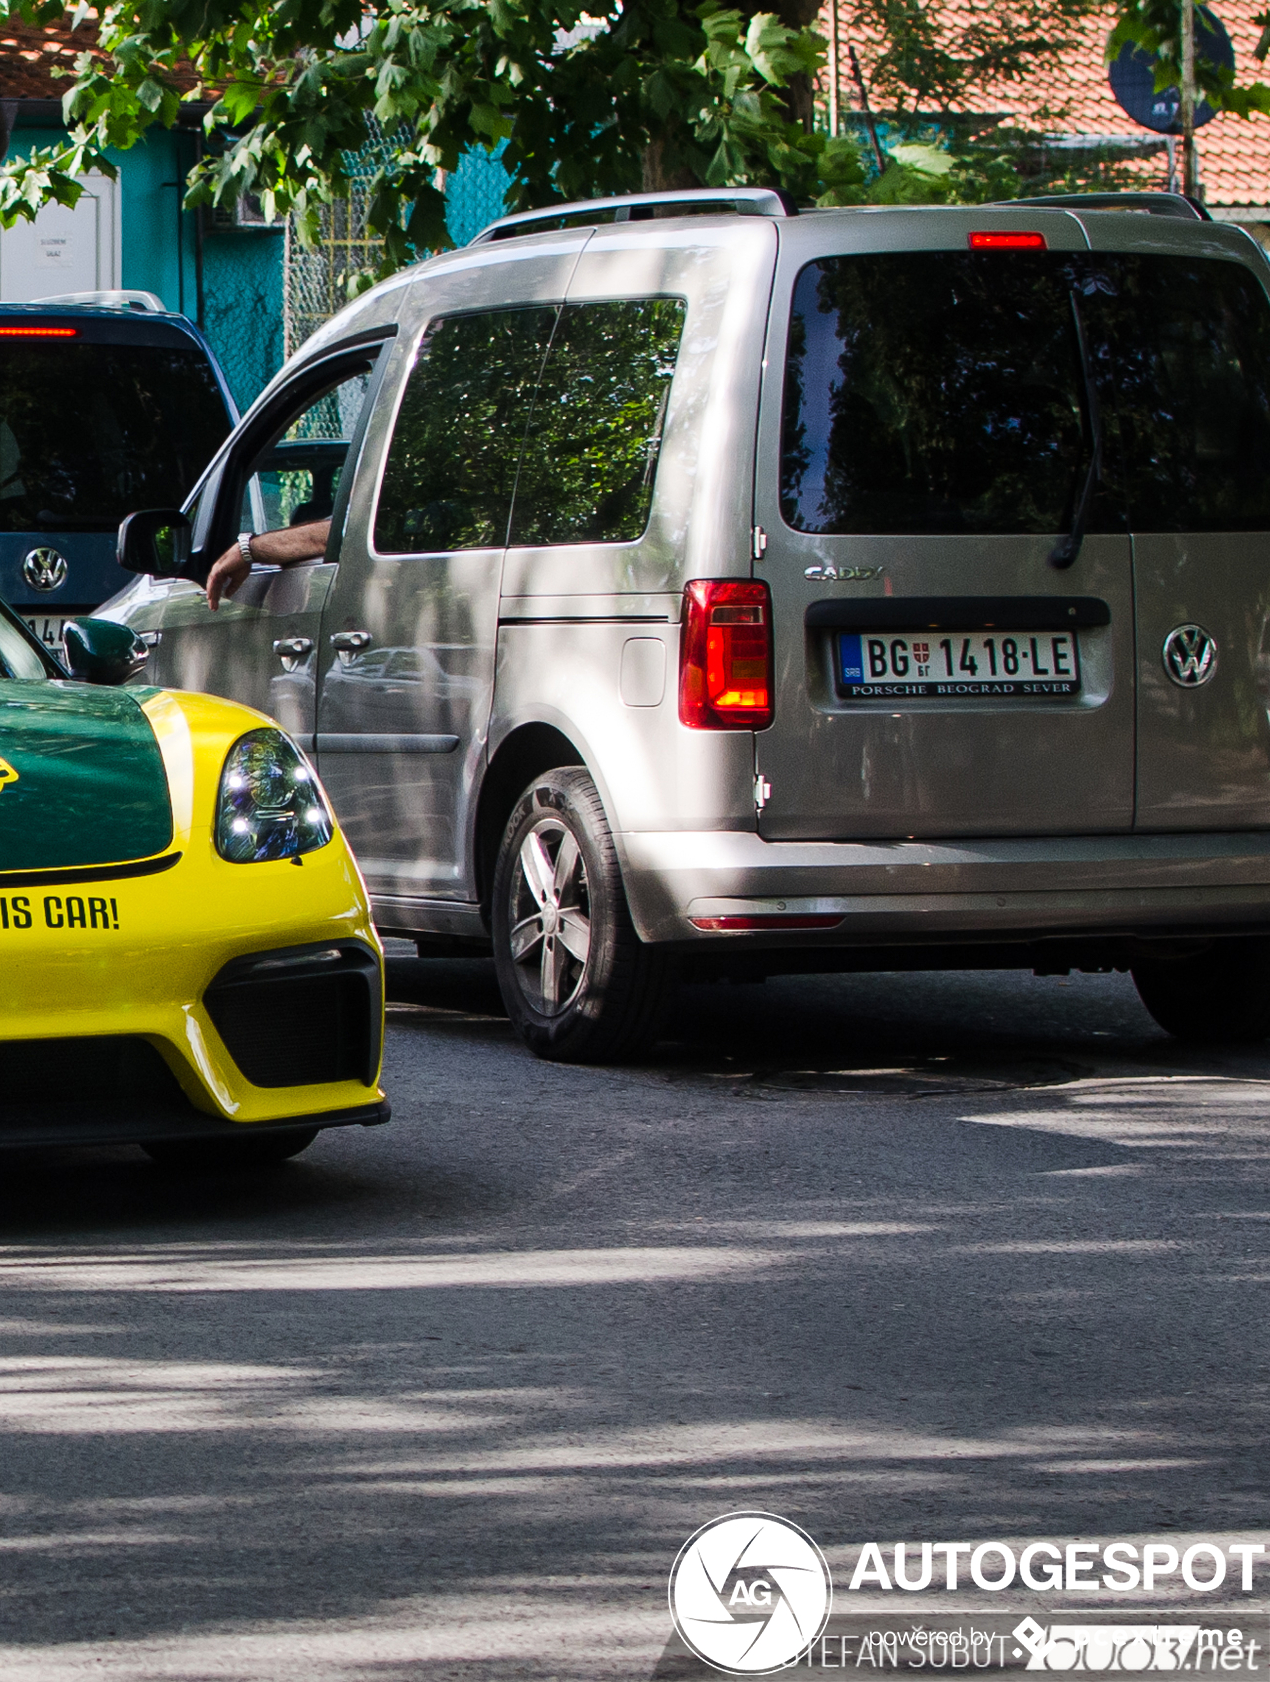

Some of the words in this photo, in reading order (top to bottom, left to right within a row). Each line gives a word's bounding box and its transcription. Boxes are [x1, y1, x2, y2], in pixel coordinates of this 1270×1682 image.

[868, 639, 909, 678] BG
[852, 685, 927, 696] PORSCHE
[937, 684, 1014, 694] BEOGRAD
[1023, 683, 1071, 693] SEVER
[43, 896, 119, 930] CAR!
